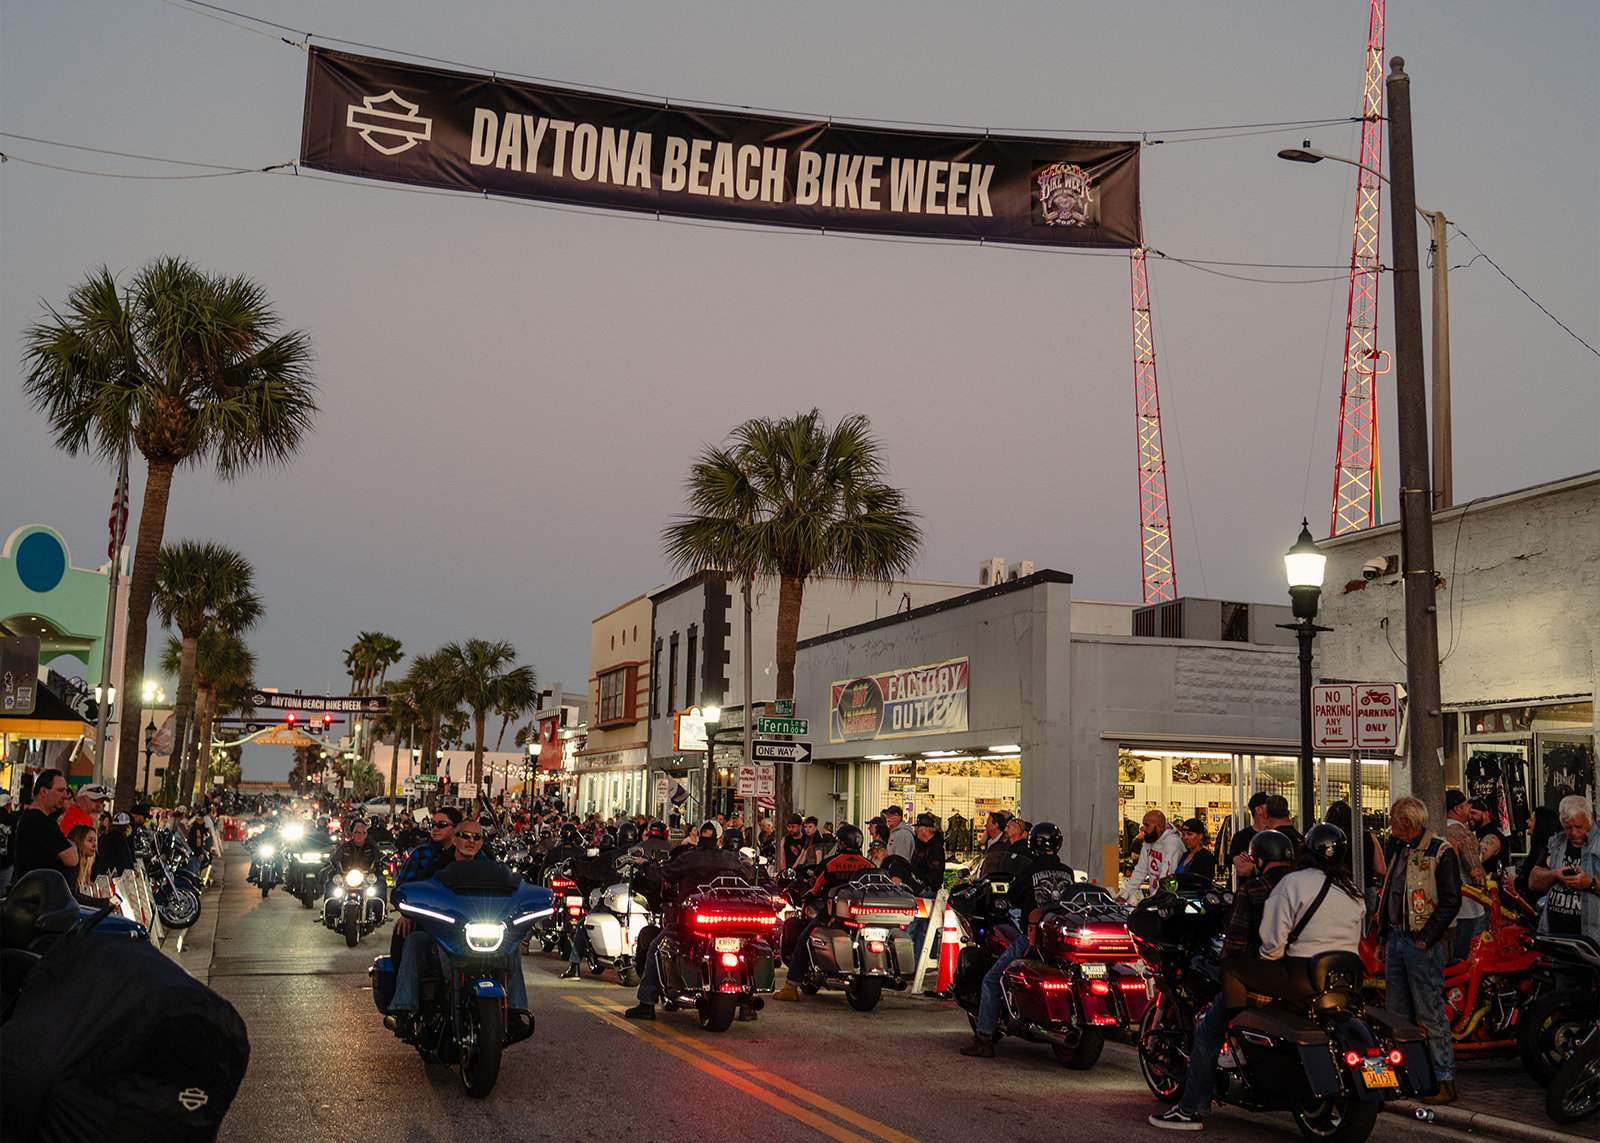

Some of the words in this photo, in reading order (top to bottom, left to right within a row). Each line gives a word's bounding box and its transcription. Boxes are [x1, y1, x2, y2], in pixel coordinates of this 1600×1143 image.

[470, 107, 653, 189] DAYTONA
[661, 136, 788, 204] BEACH
[795, 150, 884, 211] BIKE
[889, 157, 996, 217] WEEK
[1038, 173, 1063, 202] BIKE
[1064, 173, 1094, 203] WEEK
[888, 664, 962, 702] FACTORY
[851, 689, 868, 708] HOT
[1325, 690, 1341, 703] NO
[270, 696, 302, 708] DAYTONA
[302, 699, 324, 711] BEACH
[325, 700, 342, 711] BIKE
[341, 701, 362, 711] WEEK
[1315, 704, 1352, 717] PARKING
[1357, 708, 1396, 718] PARKING
[763, 719, 789, 733] Fern
[842, 713, 877, 735] LEATHERS
[1325, 717, 1342, 726] ANY
[1365, 723, 1388, 732] ONLY
[1325, 726, 1343, 736] TIME
[758, 746, 775, 755] ONE
[777, 747, 795, 757] WAY
[835, 862, 868, 870] HARLEY
